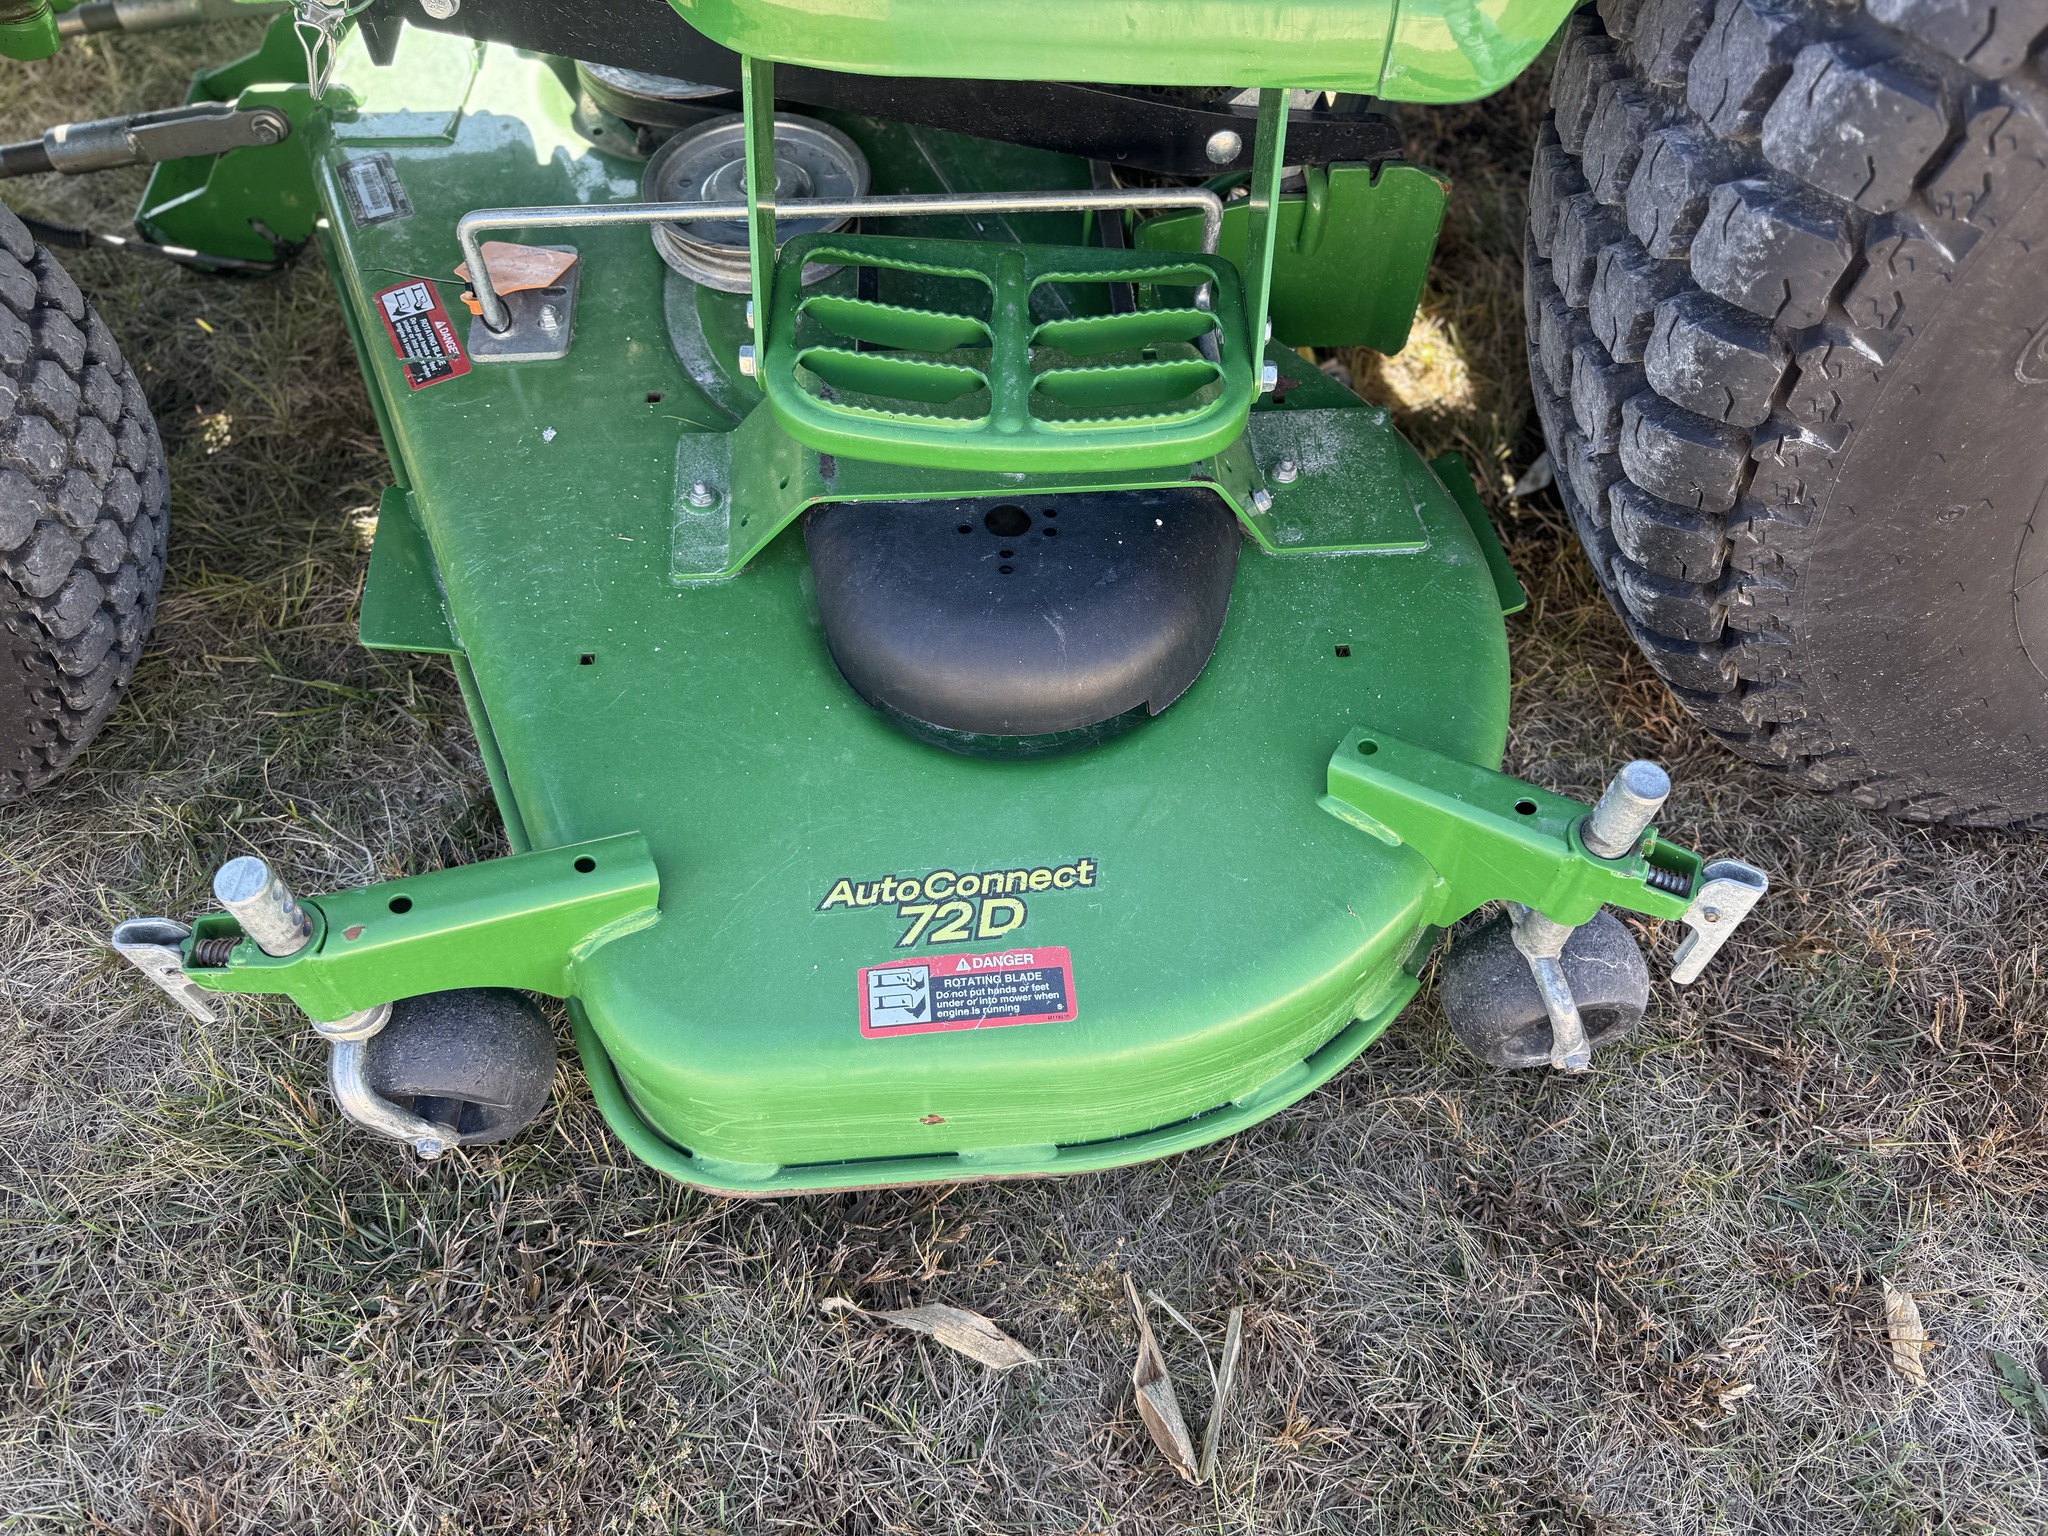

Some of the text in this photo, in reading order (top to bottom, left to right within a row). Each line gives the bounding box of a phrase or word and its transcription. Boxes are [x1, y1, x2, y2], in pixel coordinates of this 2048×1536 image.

[391, 181, 406, 202] DEERE
[393, 322, 406, 338] engine
[412, 323, 421, 333] not
[415, 332, 424, 341] put
[419, 317, 446, 366] ROTATING BLAE
[419, 340, 430, 355] hands
[421, 364, 431, 378] when
[893, 896, 1028, 948] 72D
[972, 952, 1034, 969] DANGER
[943, 970, 1042, 988] ROTATING BLADE
[935, 990, 949, 999] Do
[951, 989, 967, 998] not
[969, 988, 985, 997] put
[987, 985, 1016, 995] hands
[1031, 982, 1049, 991] feet
[936, 998, 964, 1008] under
[979, 995, 997, 1004] into
[1000, 993, 1031, 1003] mower
[1034, 990, 1059, 1000] when
[936, 1002, 1020, 1019] engine is running
